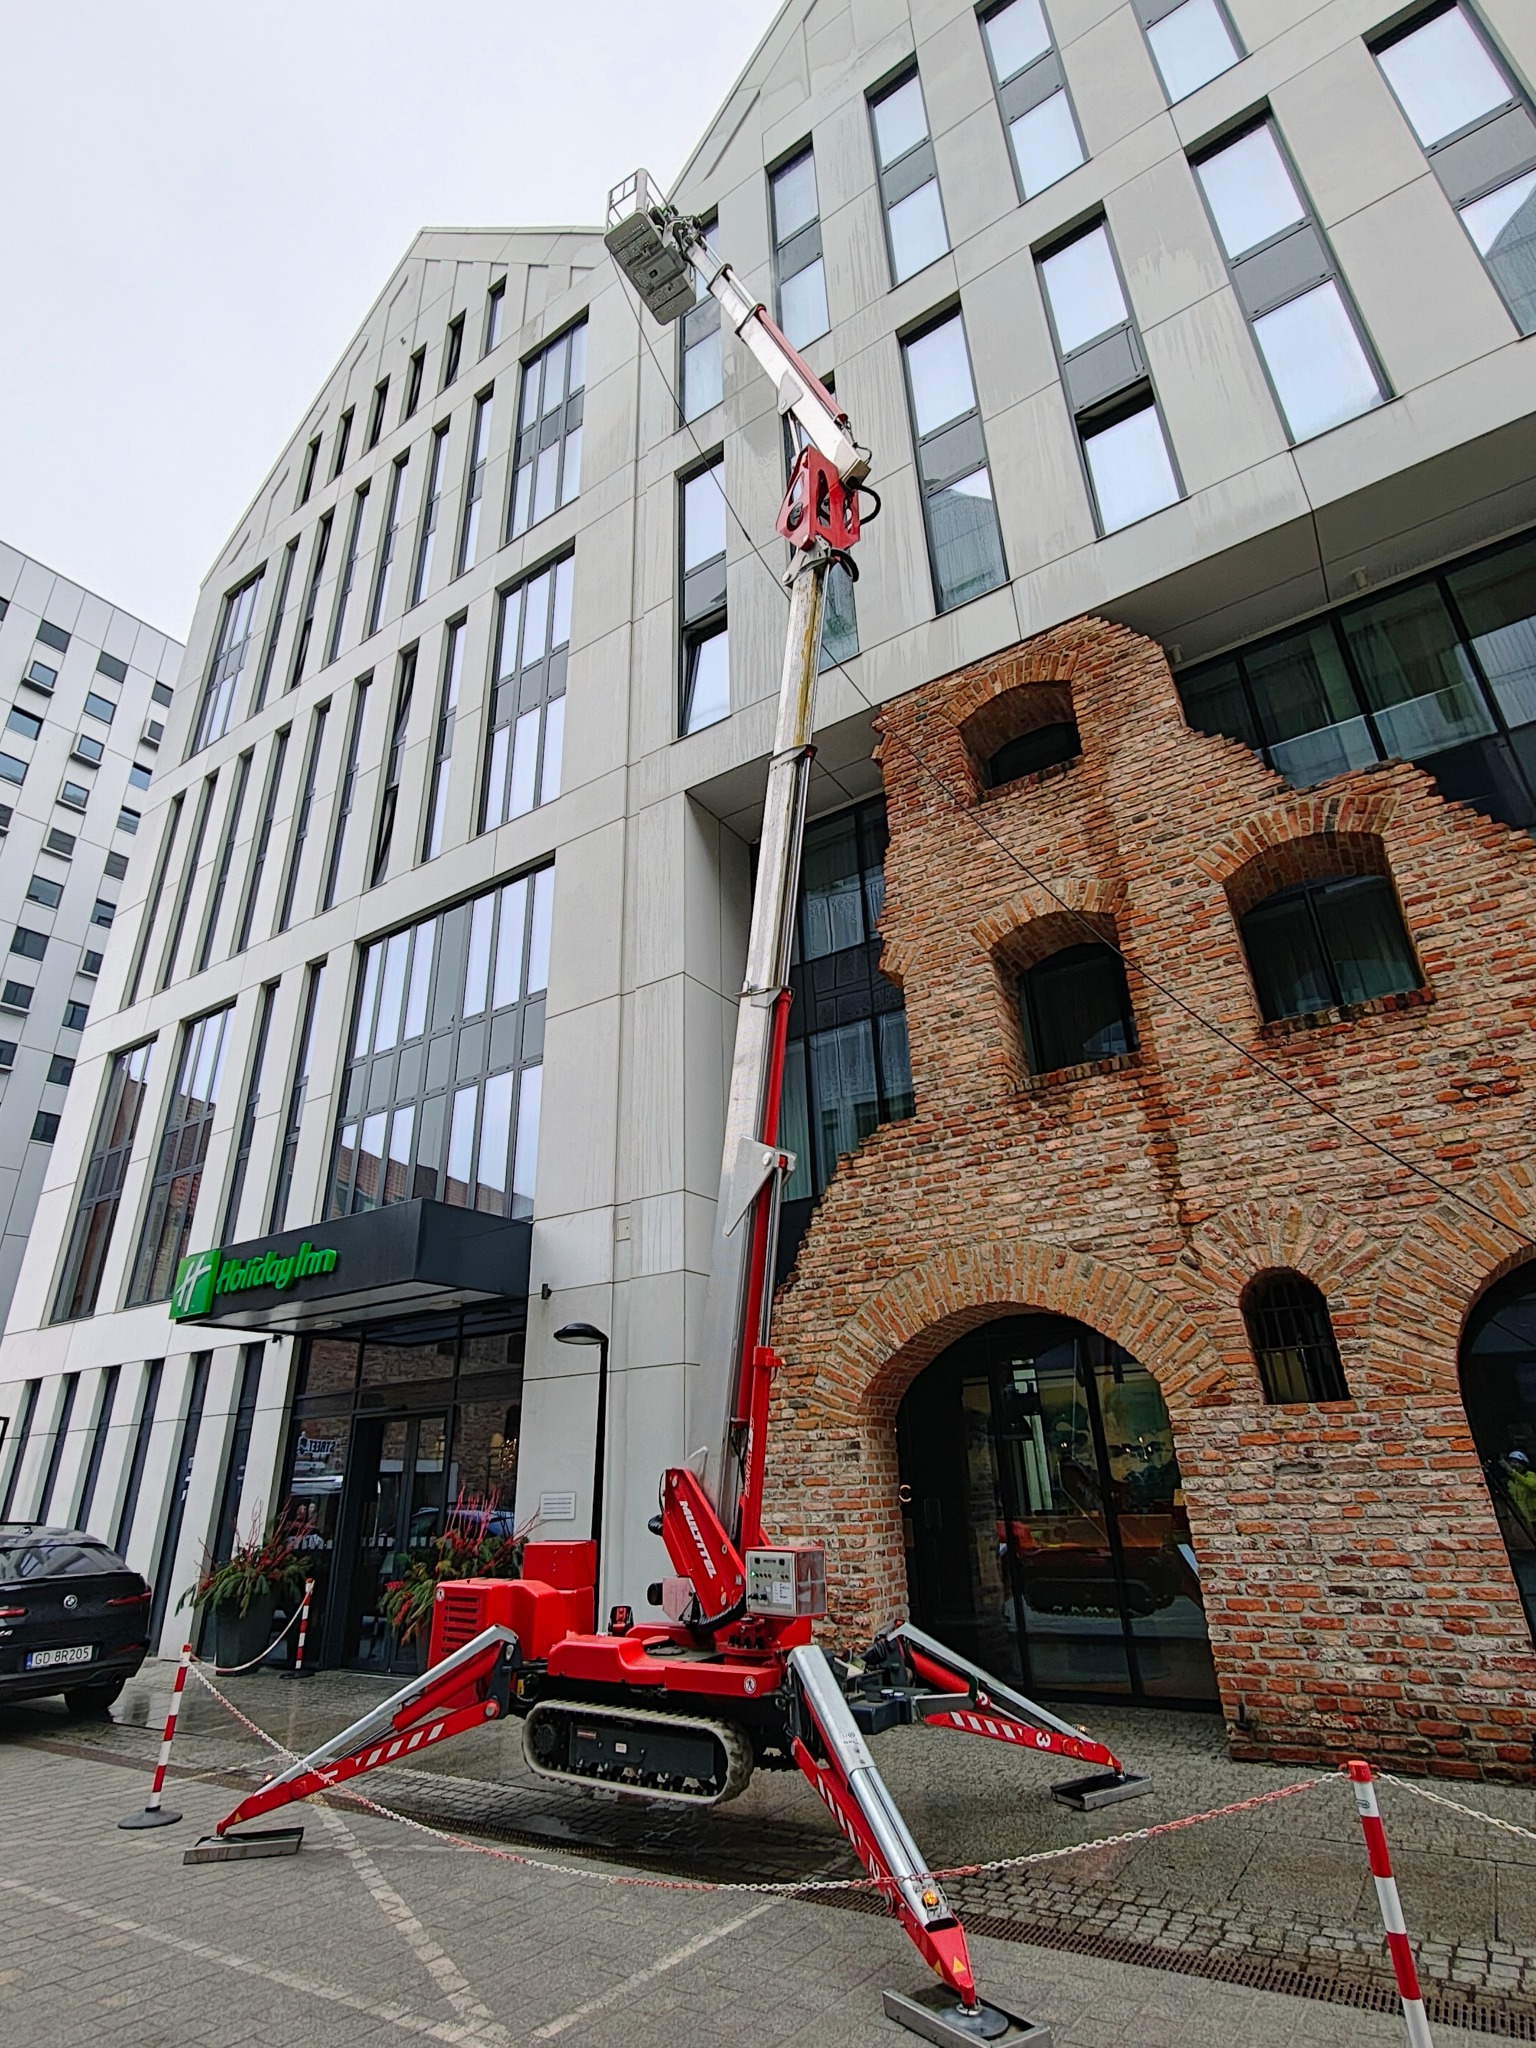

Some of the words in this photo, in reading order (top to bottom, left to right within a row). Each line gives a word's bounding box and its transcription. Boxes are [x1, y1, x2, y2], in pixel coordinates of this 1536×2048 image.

[215, 1250, 295, 1291] Holiday
[294, 1241, 337, 1279] Inn
[678, 1500, 718, 1580] MULTITEL
[35, 1652, 51, 1665] GD
[54, 1647, 90, 1663] 8R205
[1035, 1731, 1051, 1748] 3
